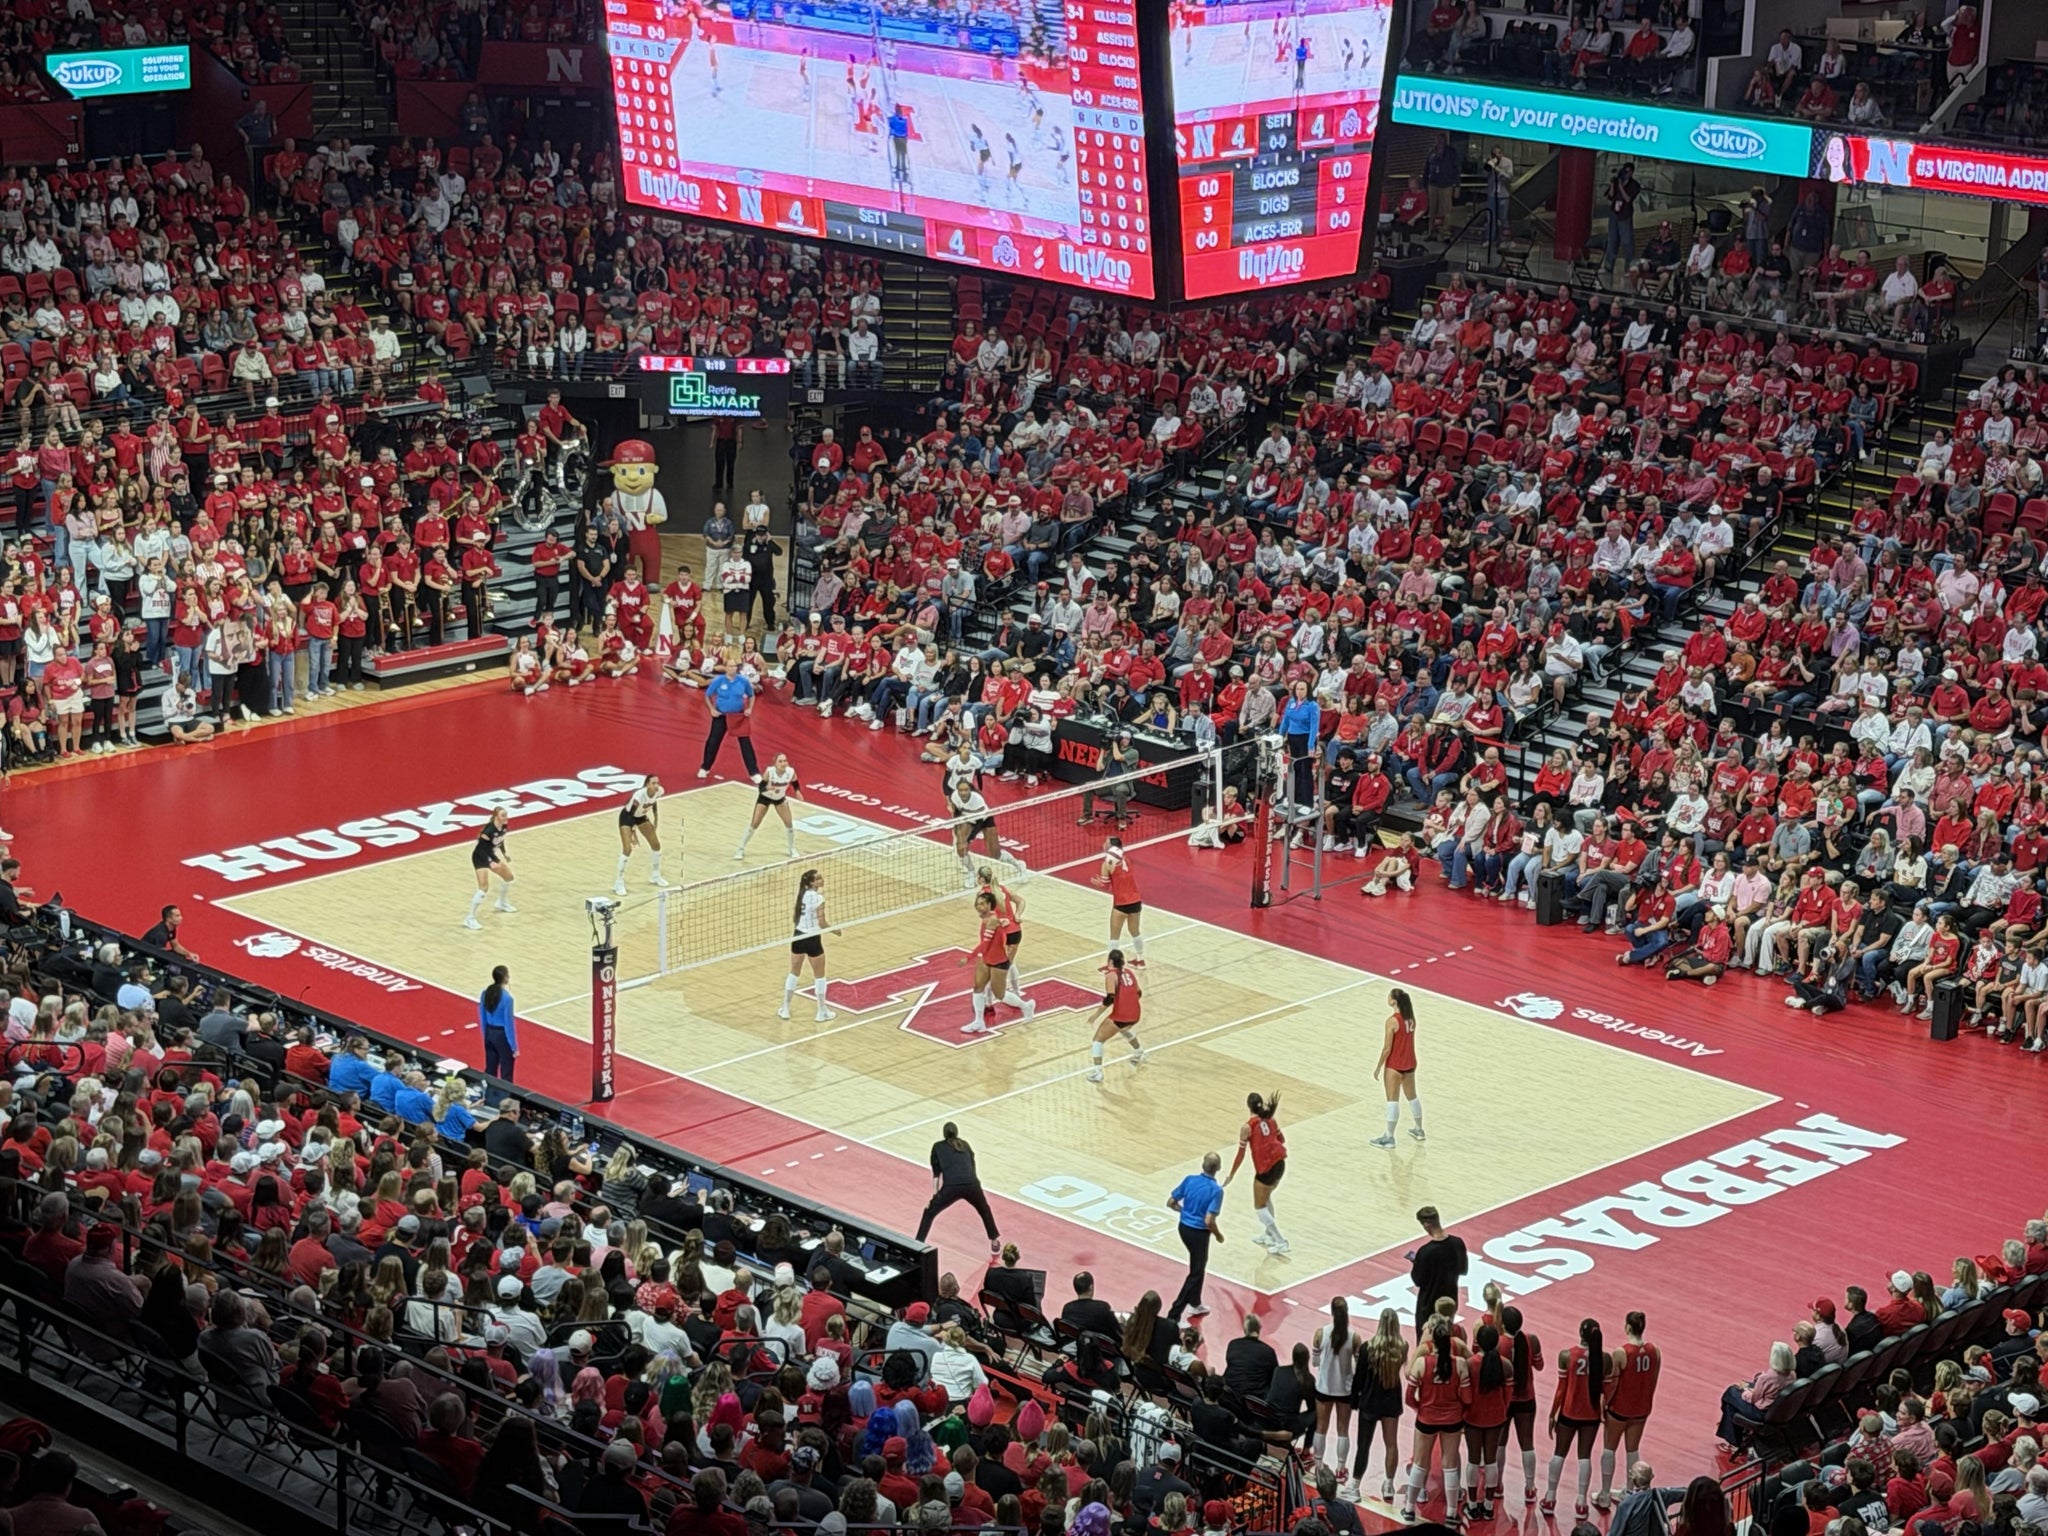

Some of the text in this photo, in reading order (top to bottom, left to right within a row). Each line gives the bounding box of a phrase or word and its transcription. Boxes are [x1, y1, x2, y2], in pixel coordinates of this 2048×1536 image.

[1097, 31, 1135, 48] ASSISTS
[142, 55, 184, 65] SOLUTIONS
[143, 64, 179, 74] FOR YOUR
[546, 48, 583, 83] N
[1098, 52, 1136, 69] BLOCKS
[59, 61, 115, 86] Sukup
[143, 72, 185, 83] OPERATION
[1129, 119, 1138, 131] D
[1312, 115, 1325, 138] 4
[1481, 100, 1509, 122] for
[1510, 108, 1557, 129] your
[1561, 115, 1658, 143] operation
[1192, 124, 1215, 159] N
[1231, 124, 1246, 149] 4
[1267, 113, 1286, 129] SET
[1269, 134, 1287, 149] 0-0
[1698, 123, 1758, 157] Sukup
[1865, 139, 1913, 186] N
[1936, 158, 2006, 187] VIRGINIA
[1199, 160, 1352, 198] 0.0 BLOCKS 0.0
[1260, 196, 1289, 215] DIGS
[739, 187, 764, 223] N
[788, 201, 804, 226] 4
[858, 207, 881, 224] SET
[949, 229, 966, 256] 4
[1196, 211, 1351, 250] 0-0 ACES-ERR 0-0
[1058, 243, 1132, 284] HyVee
[1239, 244, 1305, 285] HyVee
[610, 385, 624, 397] EXIT
[708, 385, 736, 395] Retire
[809, 391, 823, 402] EXIT
[702, 396, 760, 408] SMART
[625, 511, 646, 531] N
[806, 782, 881, 807] COURT
[181, 765, 649, 881] HUSKERS
[302, 946, 424, 993] Ameritas
[1405, 1019, 1415, 1034] 12
[1571, 1007, 1724, 1057] Ameritas
[602, 985, 613, 1098] NEBRASKA
[1260, 1120, 1270, 1136] 8
[1636, 1355, 1650, 1373] 10
